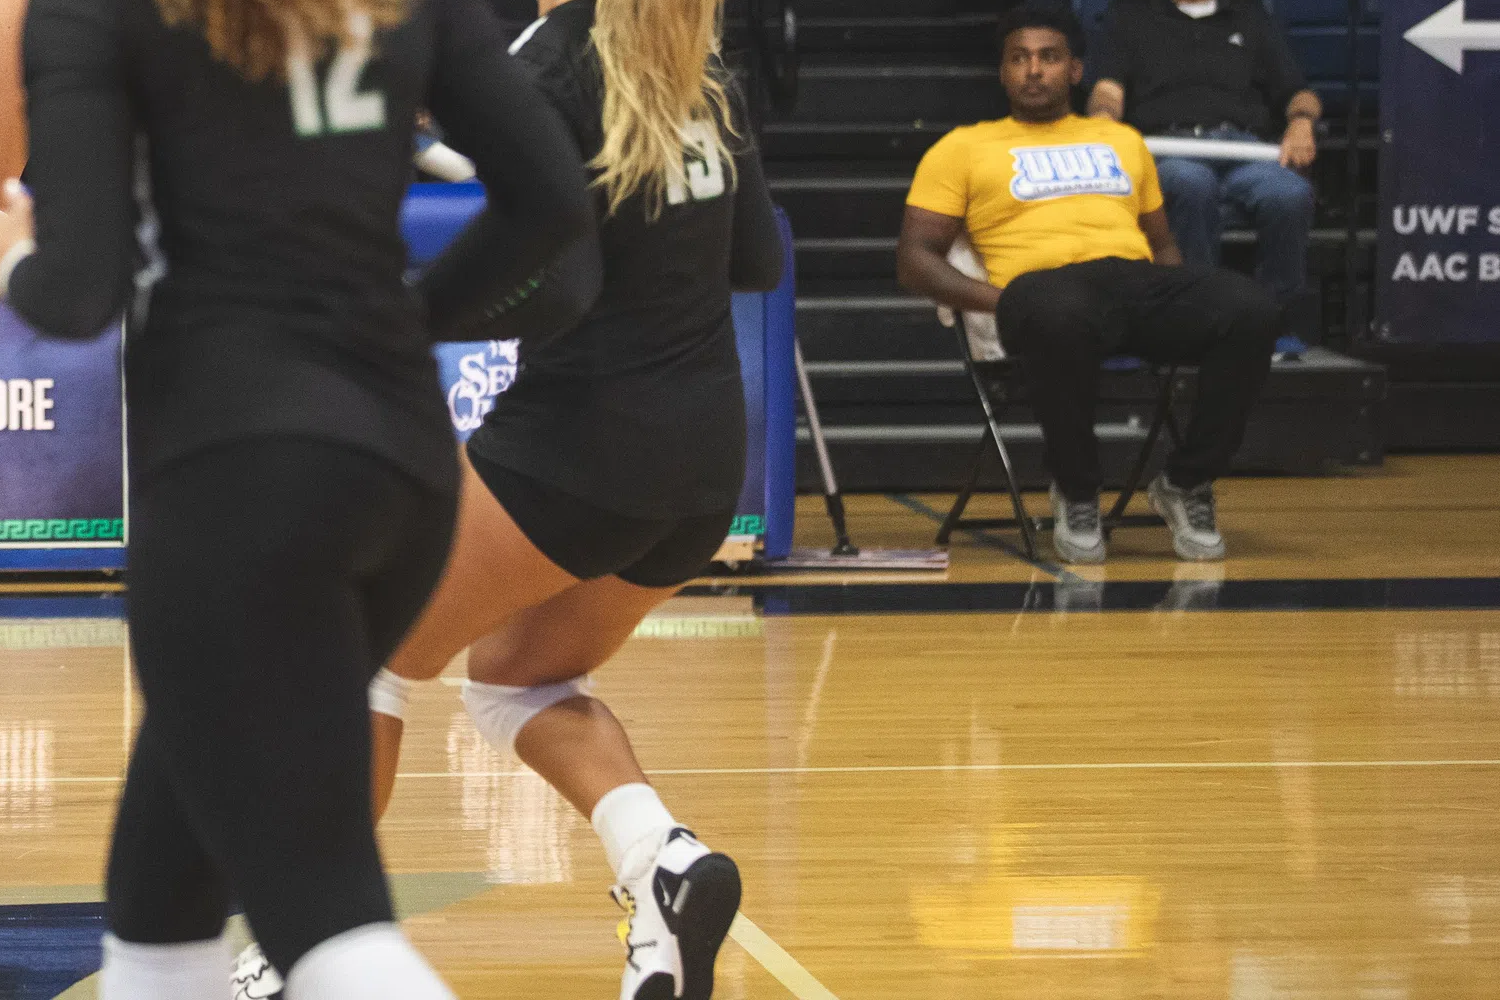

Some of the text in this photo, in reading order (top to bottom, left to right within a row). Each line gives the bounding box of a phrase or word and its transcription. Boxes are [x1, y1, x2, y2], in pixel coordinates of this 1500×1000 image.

[1017, 148, 1117, 181] UWF
[1393, 204, 1479, 235] UWF
[1391, 252, 1469, 281] AAC
